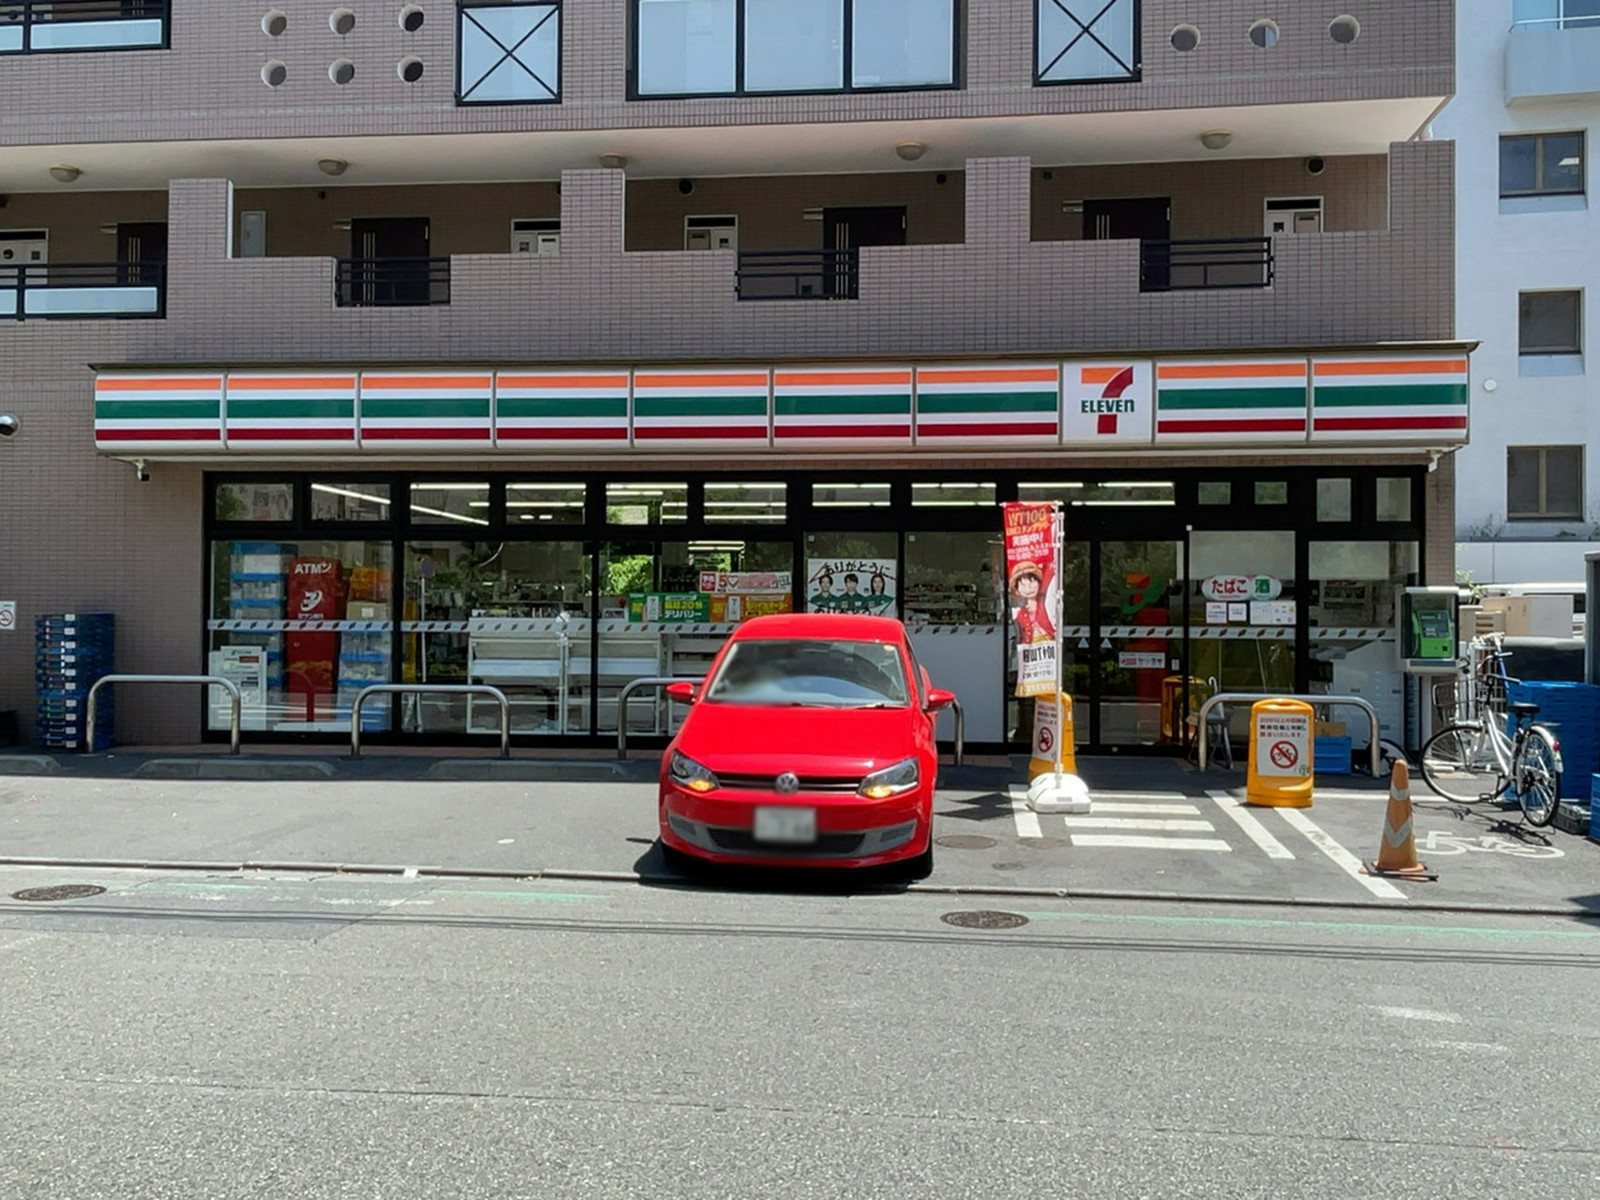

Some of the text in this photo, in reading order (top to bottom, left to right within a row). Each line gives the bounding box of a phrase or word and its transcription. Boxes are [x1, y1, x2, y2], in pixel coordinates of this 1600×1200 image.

[294, 563, 323, 575] ATM
[1211, 578, 1271, 594] たばこ 酒
